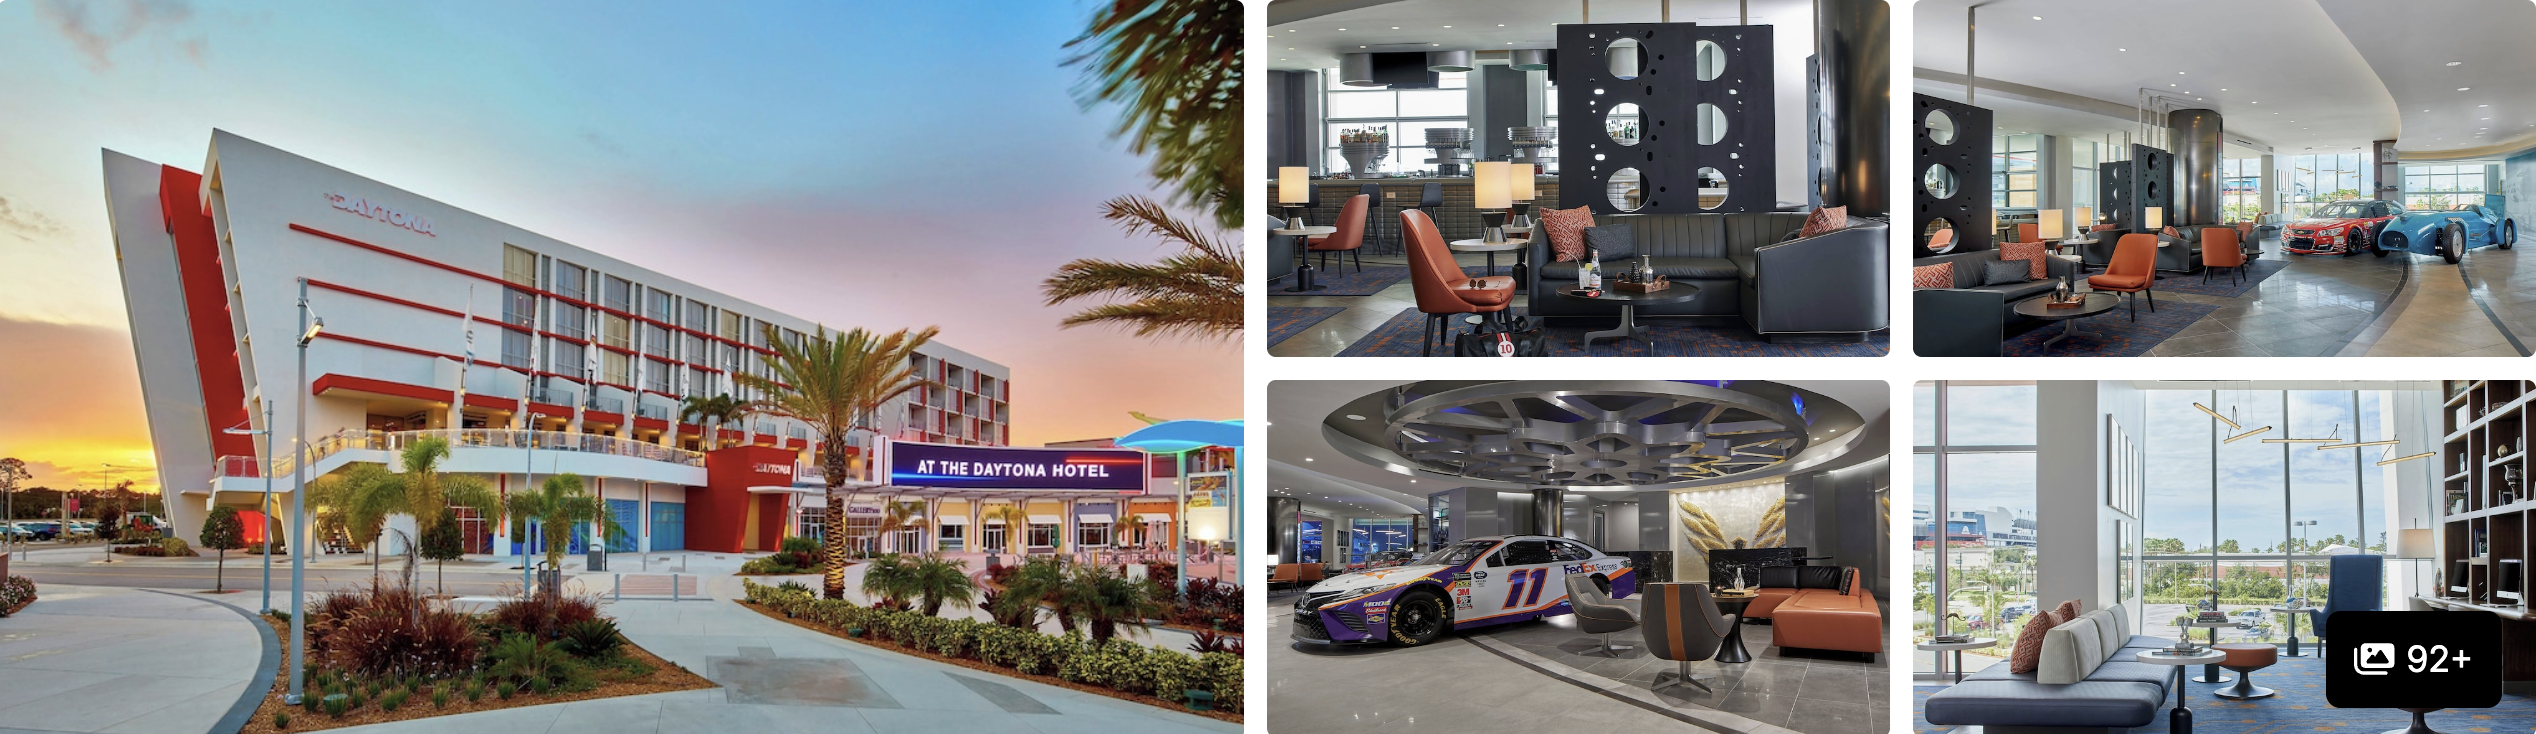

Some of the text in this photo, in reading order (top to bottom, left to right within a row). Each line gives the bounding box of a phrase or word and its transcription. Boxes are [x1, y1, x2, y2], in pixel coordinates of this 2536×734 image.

[331, 190, 436, 238] DAYTONA
[1500, 344, 1513, 354] 10
[755, 462, 791, 475] DAYTONA
[917, 460, 1109, 478] AT THE DAYTONA HOTEL
[1563, 562, 1618, 574] FedEx Express
[1457, 588, 1469, 596] 3M
[1501, 567, 1549, 610] 11
[1434, 597, 1447, 619] EAGLE
[1390, 603, 1417, 645] GOODYEAR
